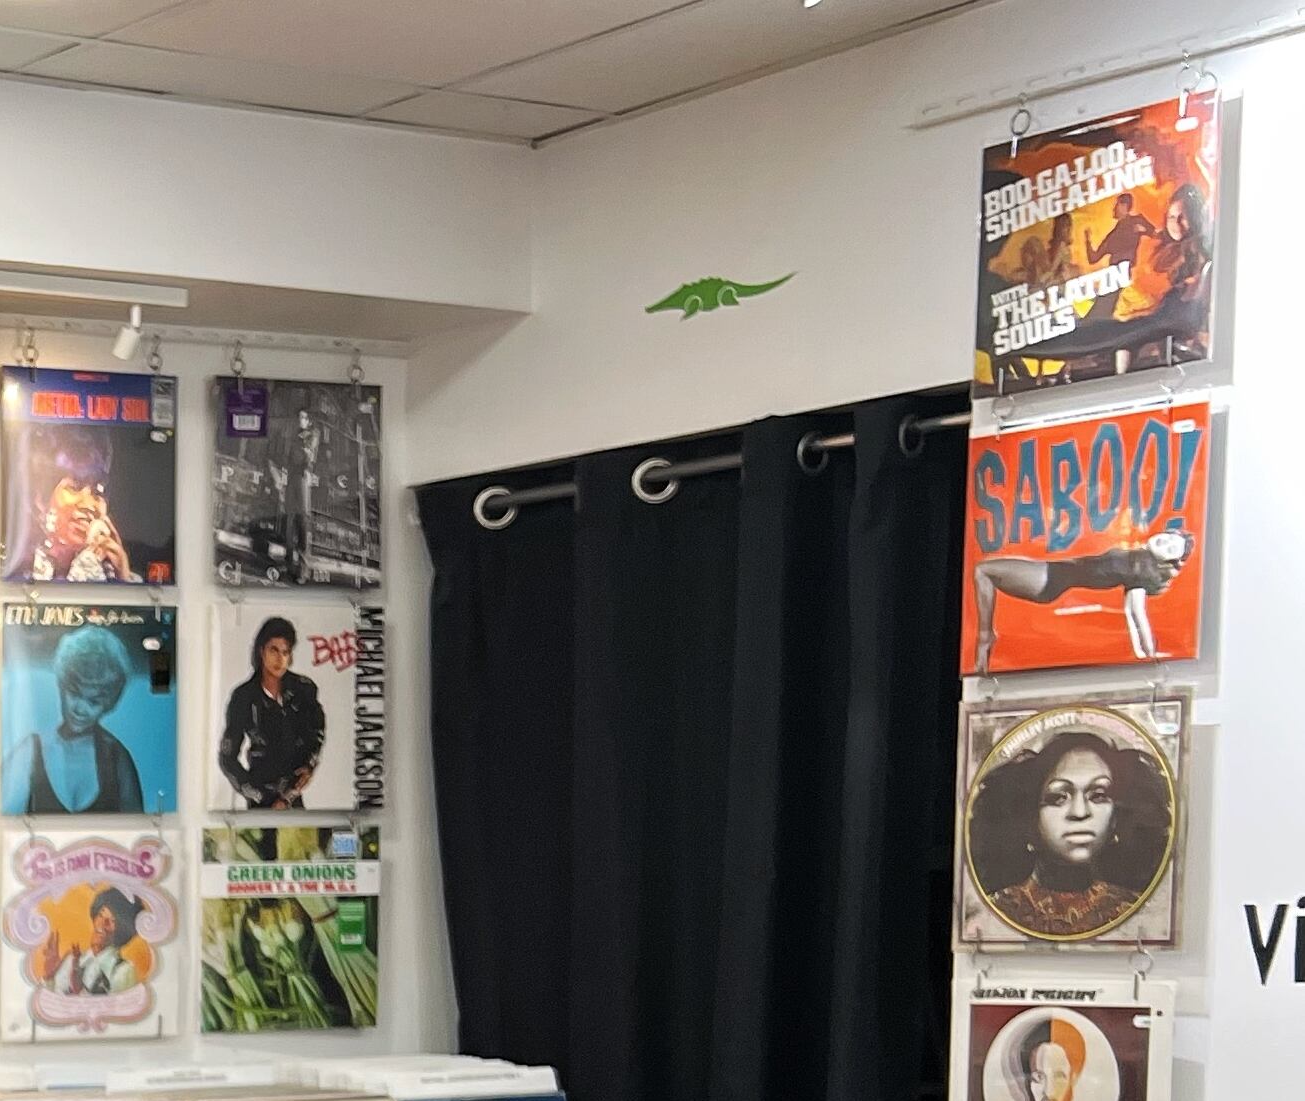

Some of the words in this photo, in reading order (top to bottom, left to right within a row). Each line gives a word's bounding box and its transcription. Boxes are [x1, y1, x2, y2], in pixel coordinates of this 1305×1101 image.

[992, 289, 1047, 334] THE
[1047, 260, 1133, 309] LATIN
[993, 307, 1076, 356] SOULS
[974, 417, 1203, 553] SABOO!
[355, 606, 386, 700] MICHAEL
[353, 703, 386, 808] JACKSON
[227, 865, 284, 881] GREEN
[291, 864, 357, 881] ONIONS
